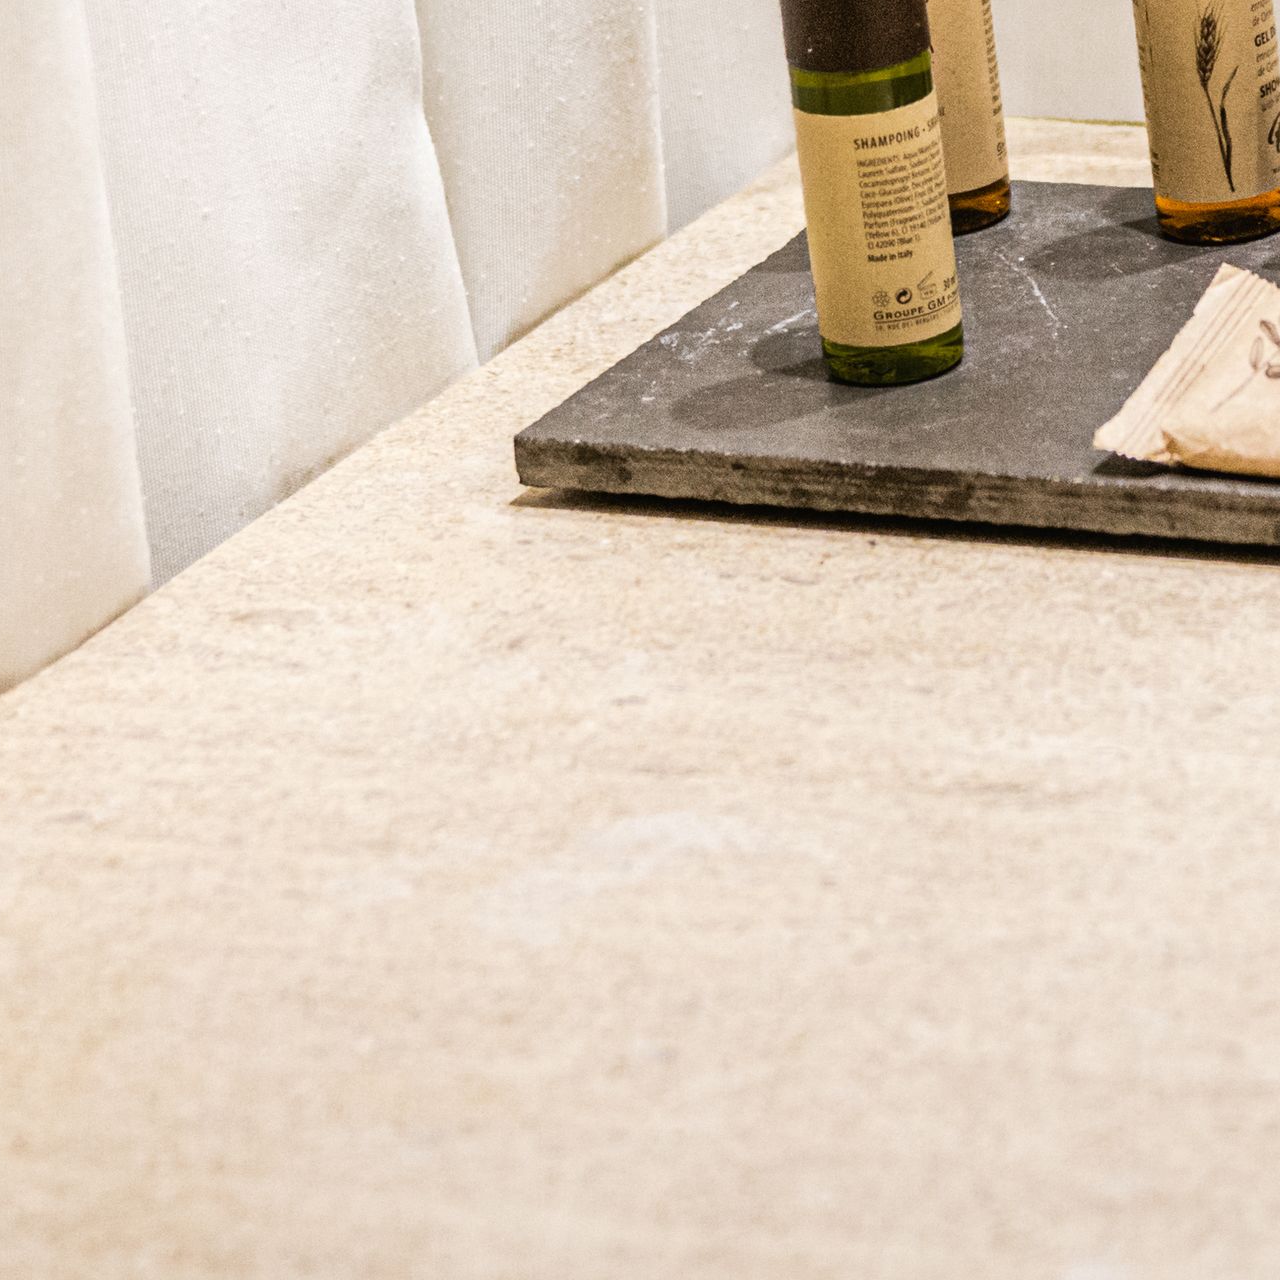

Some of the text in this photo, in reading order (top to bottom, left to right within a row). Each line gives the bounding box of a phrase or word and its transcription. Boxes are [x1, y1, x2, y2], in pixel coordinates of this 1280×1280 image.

[1254, 30, 1270, 47] GEL
[853, 126, 920, 151] SHAMPOING
[867, 253, 888, 262] Made
[889, 253, 897, 261] in
[873, 306, 925, 321] GROUPE
[927, 295, 946, 311] GM
